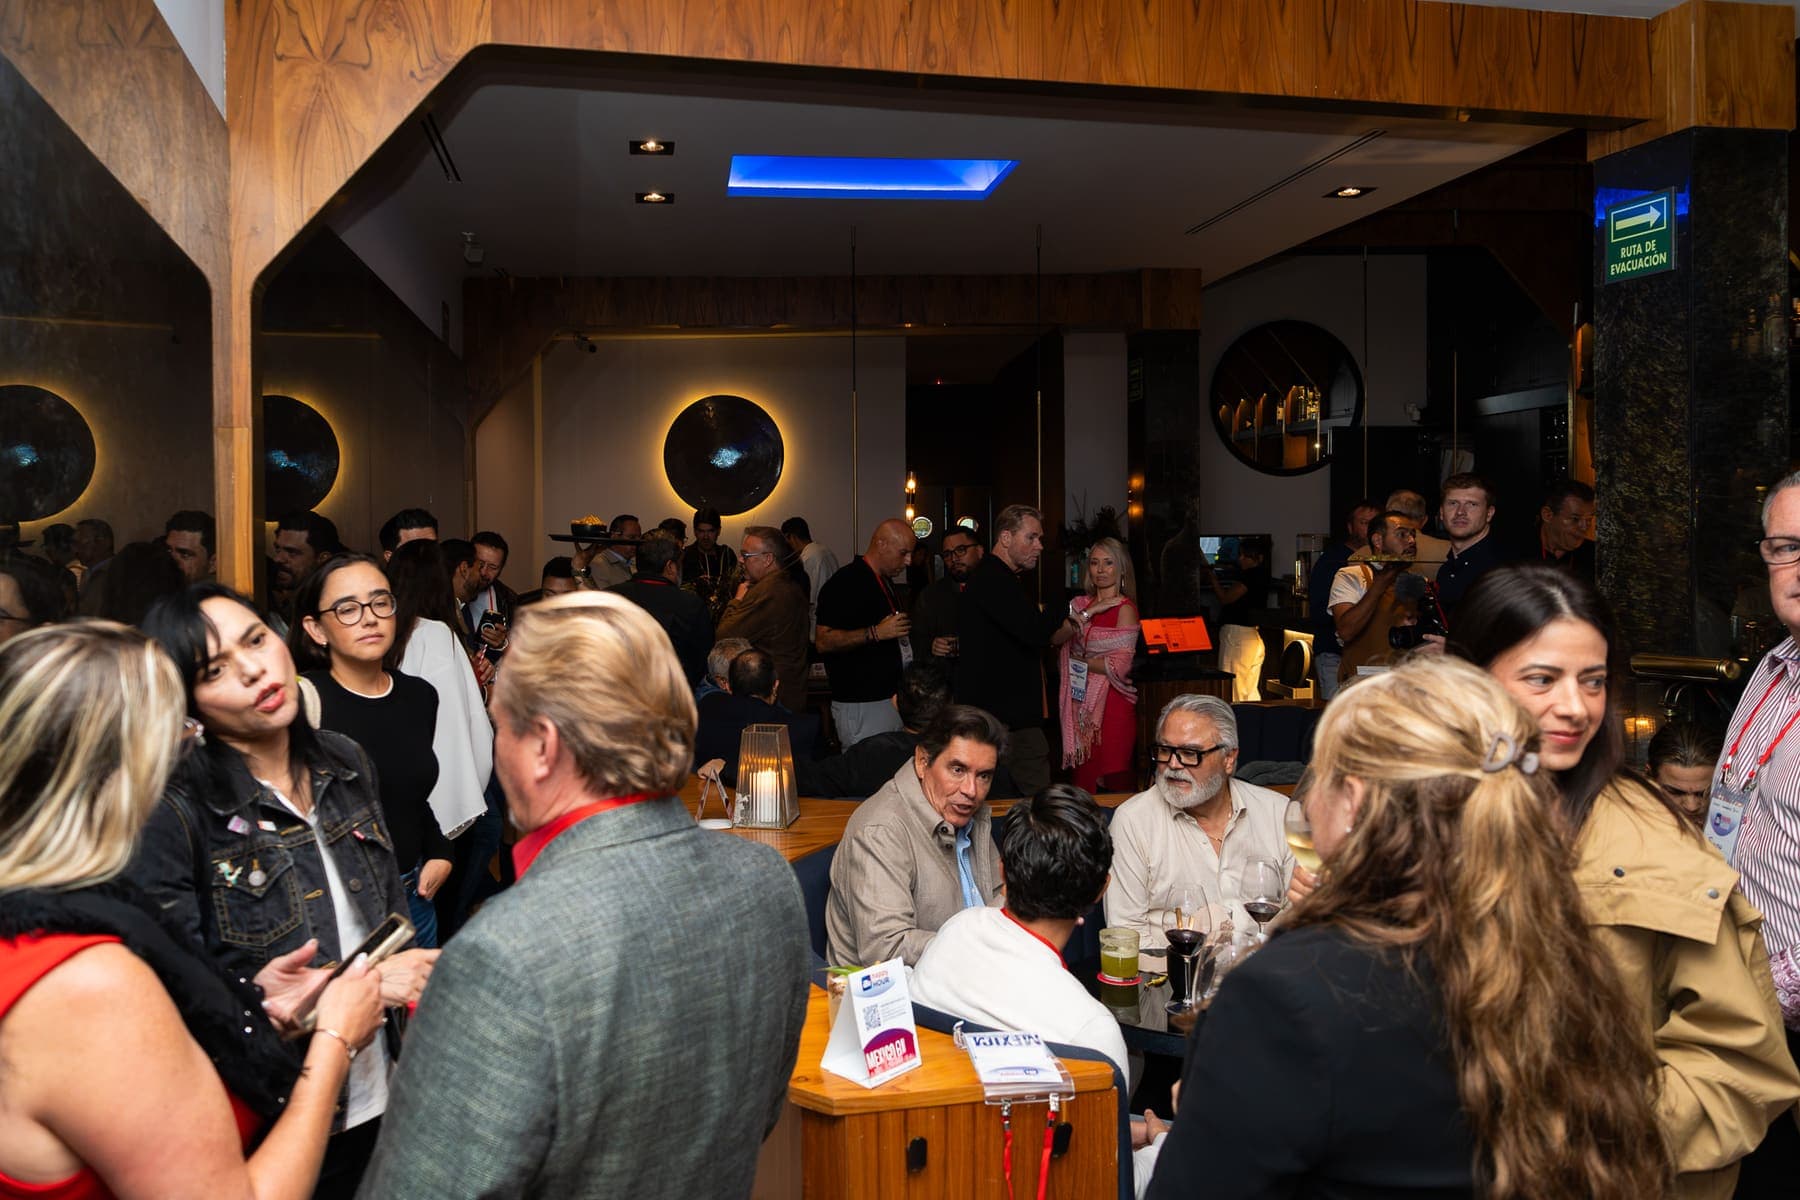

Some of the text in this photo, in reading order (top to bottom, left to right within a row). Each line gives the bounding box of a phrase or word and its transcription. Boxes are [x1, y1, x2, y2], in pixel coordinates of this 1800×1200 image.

[1620, 239, 1656, 258] RUTA DE
[1610, 251, 1667, 275] EVACUACIÓN
